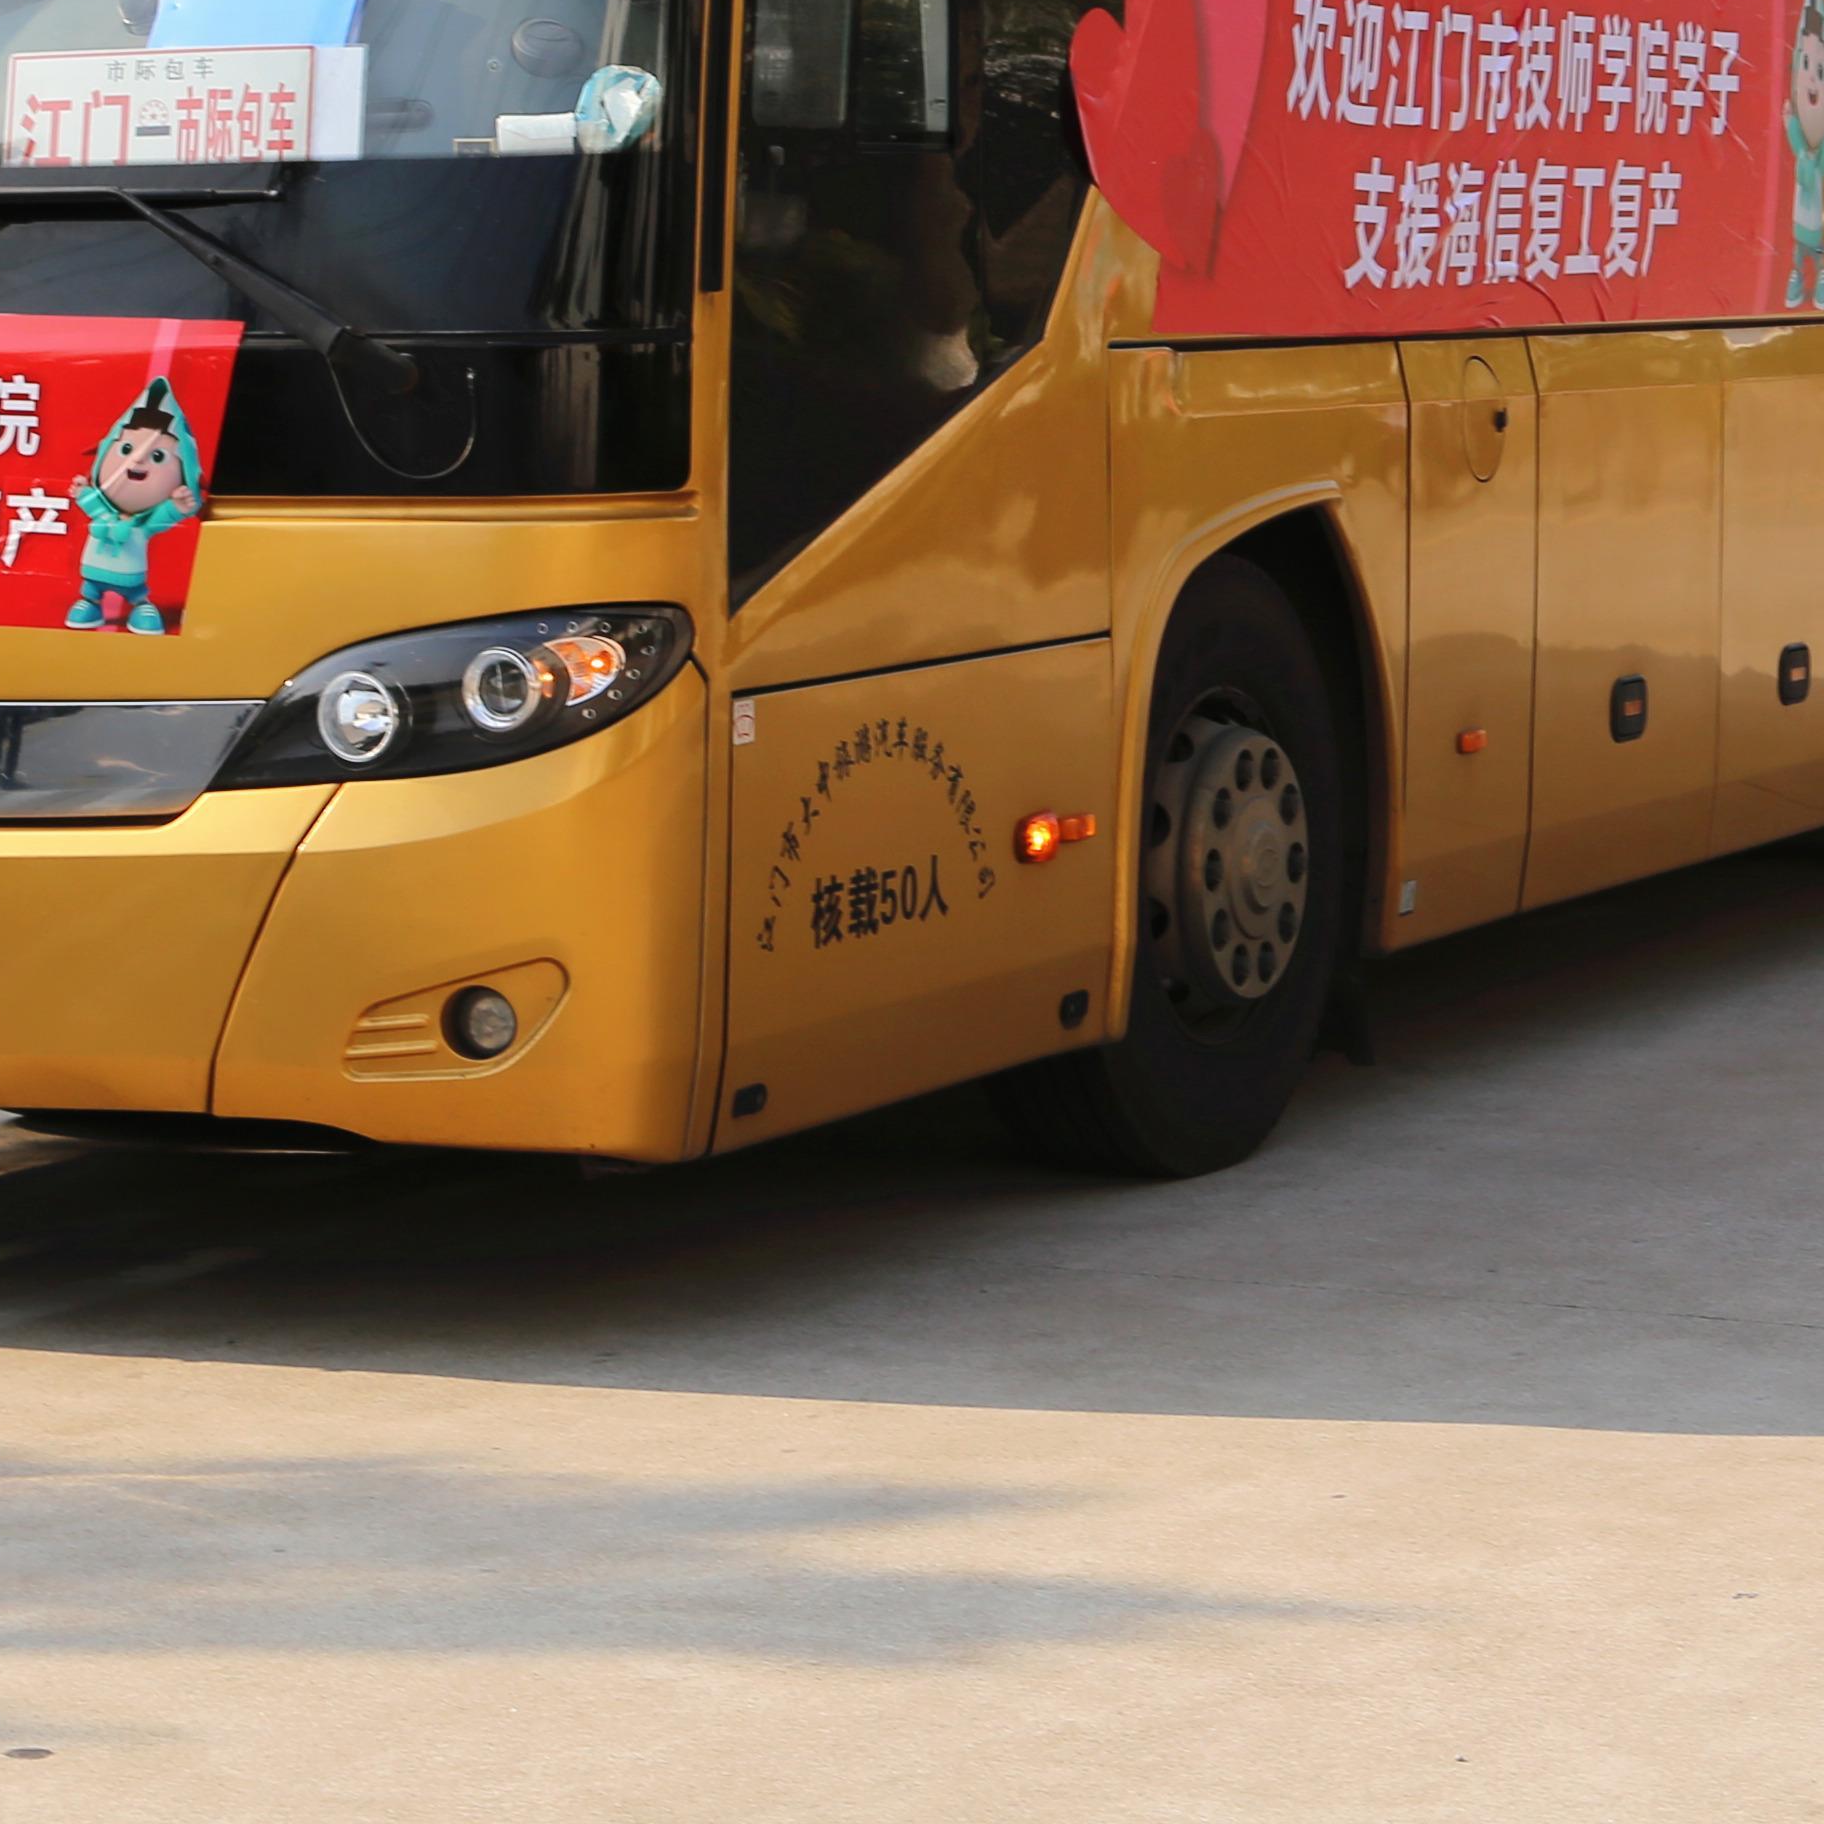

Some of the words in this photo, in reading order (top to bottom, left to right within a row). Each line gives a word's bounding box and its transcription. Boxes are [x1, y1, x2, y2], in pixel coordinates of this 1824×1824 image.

[106, 57, 216, 82] 市际包车
[1342, 155, 1684, 291] 支援海信复工复产
[810, 854, 949, 950] 核载50人
